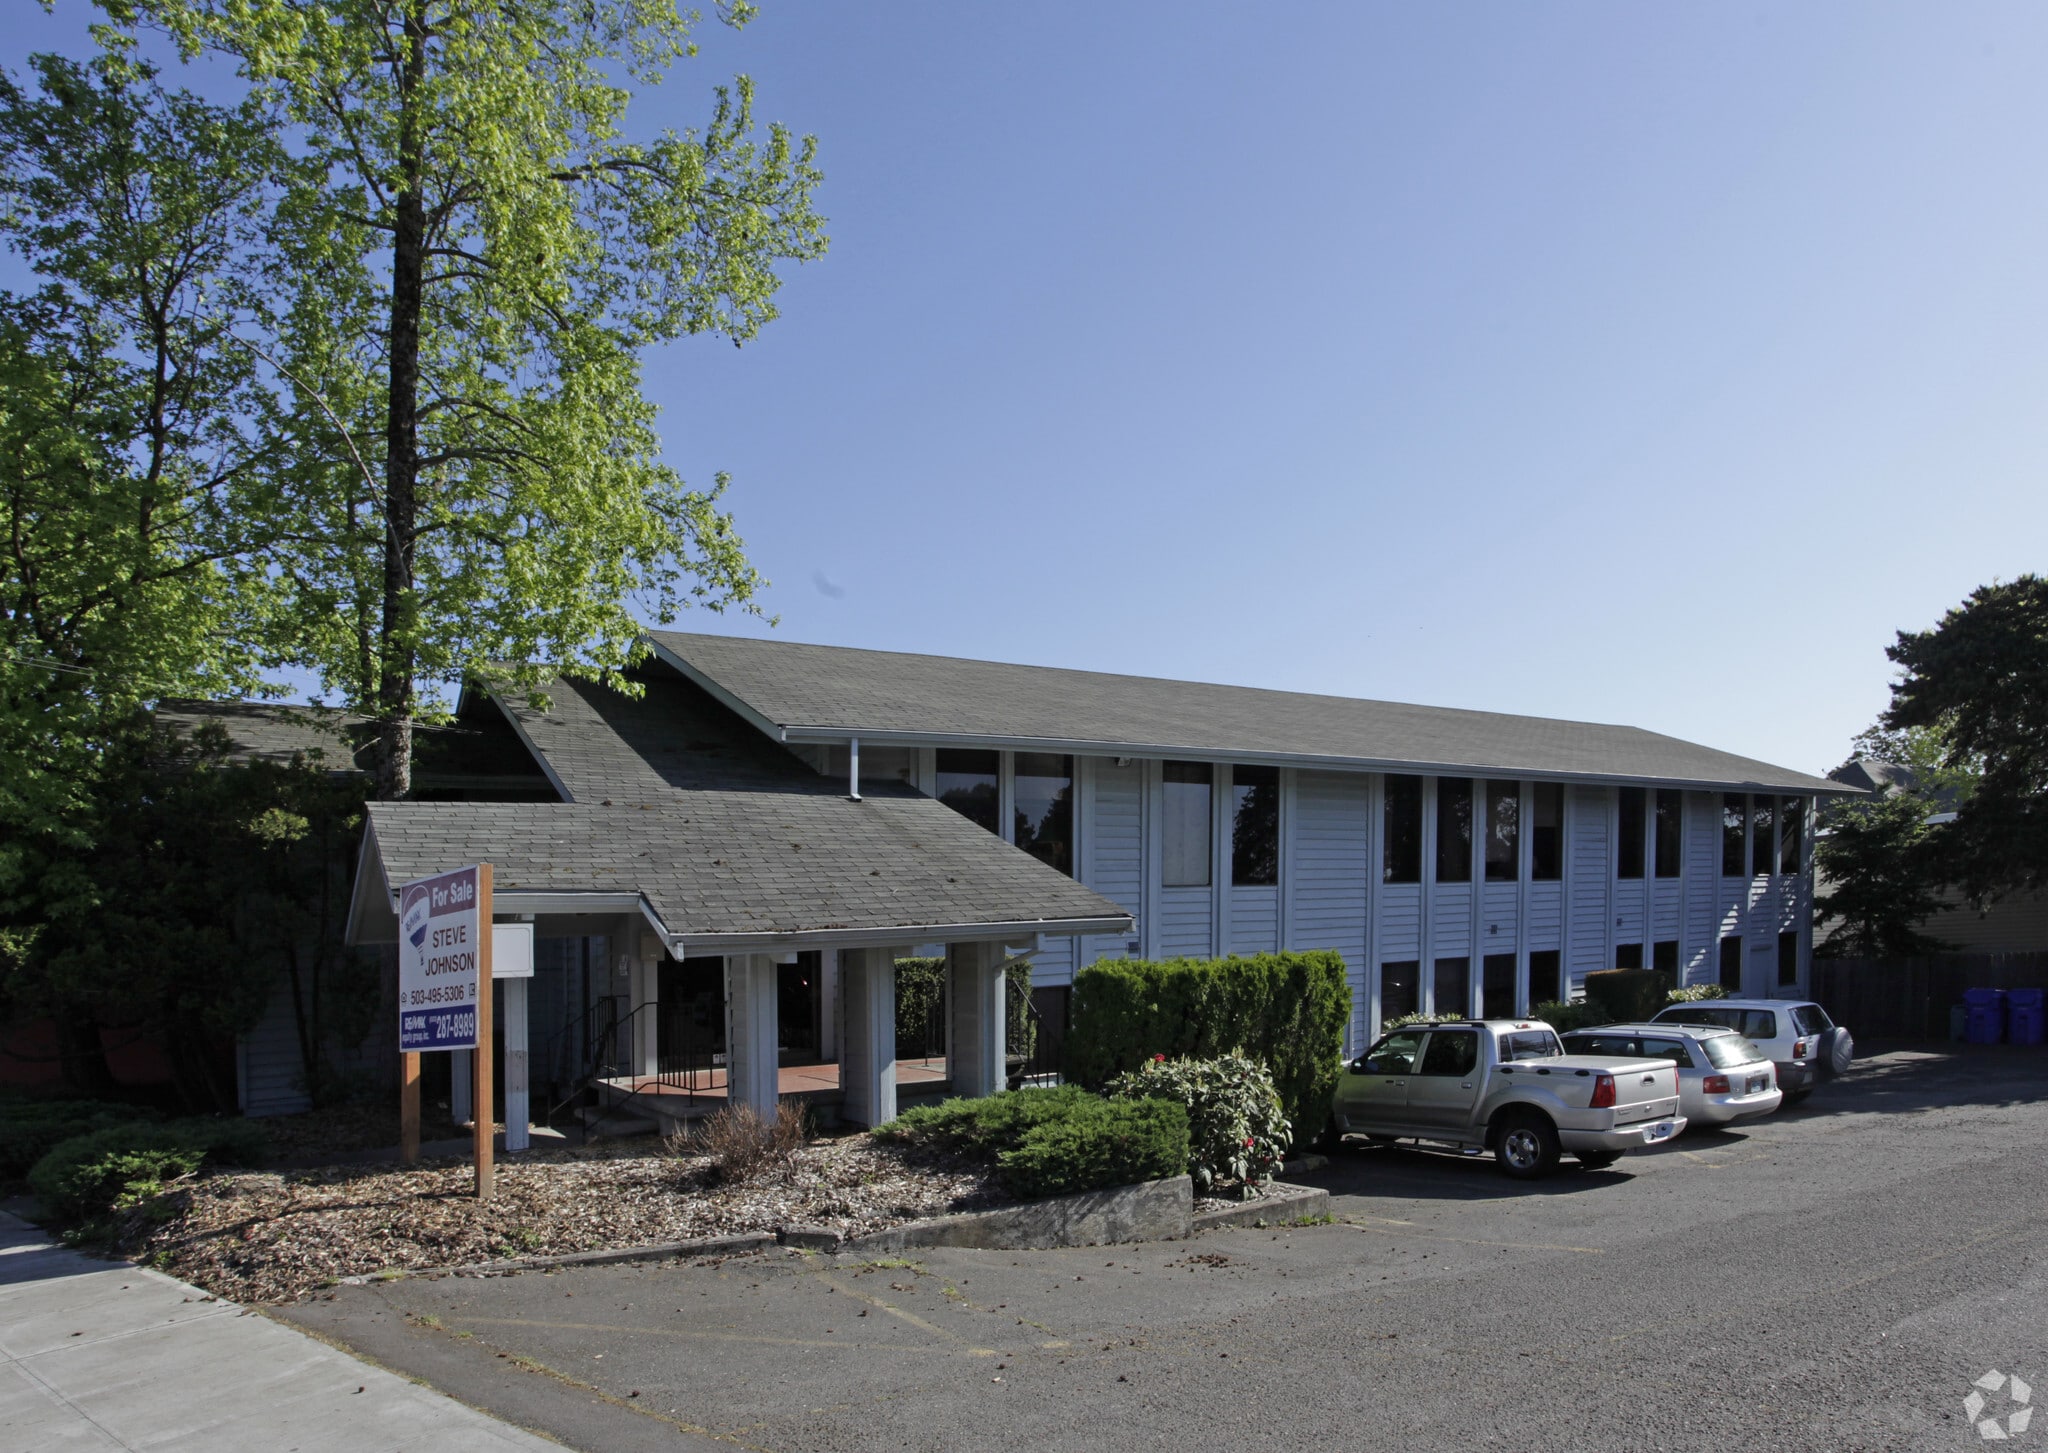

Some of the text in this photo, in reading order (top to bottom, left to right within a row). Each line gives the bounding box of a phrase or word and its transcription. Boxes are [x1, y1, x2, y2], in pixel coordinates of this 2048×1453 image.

[432, 880, 473, 908] For Sale
[432, 925, 467, 948] STEVE
[425, 952, 474, 976] JOHNSON
[410, 985, 464, 1005] 503-495-5306
[436, 1012, 474, 1039] 287-8989
